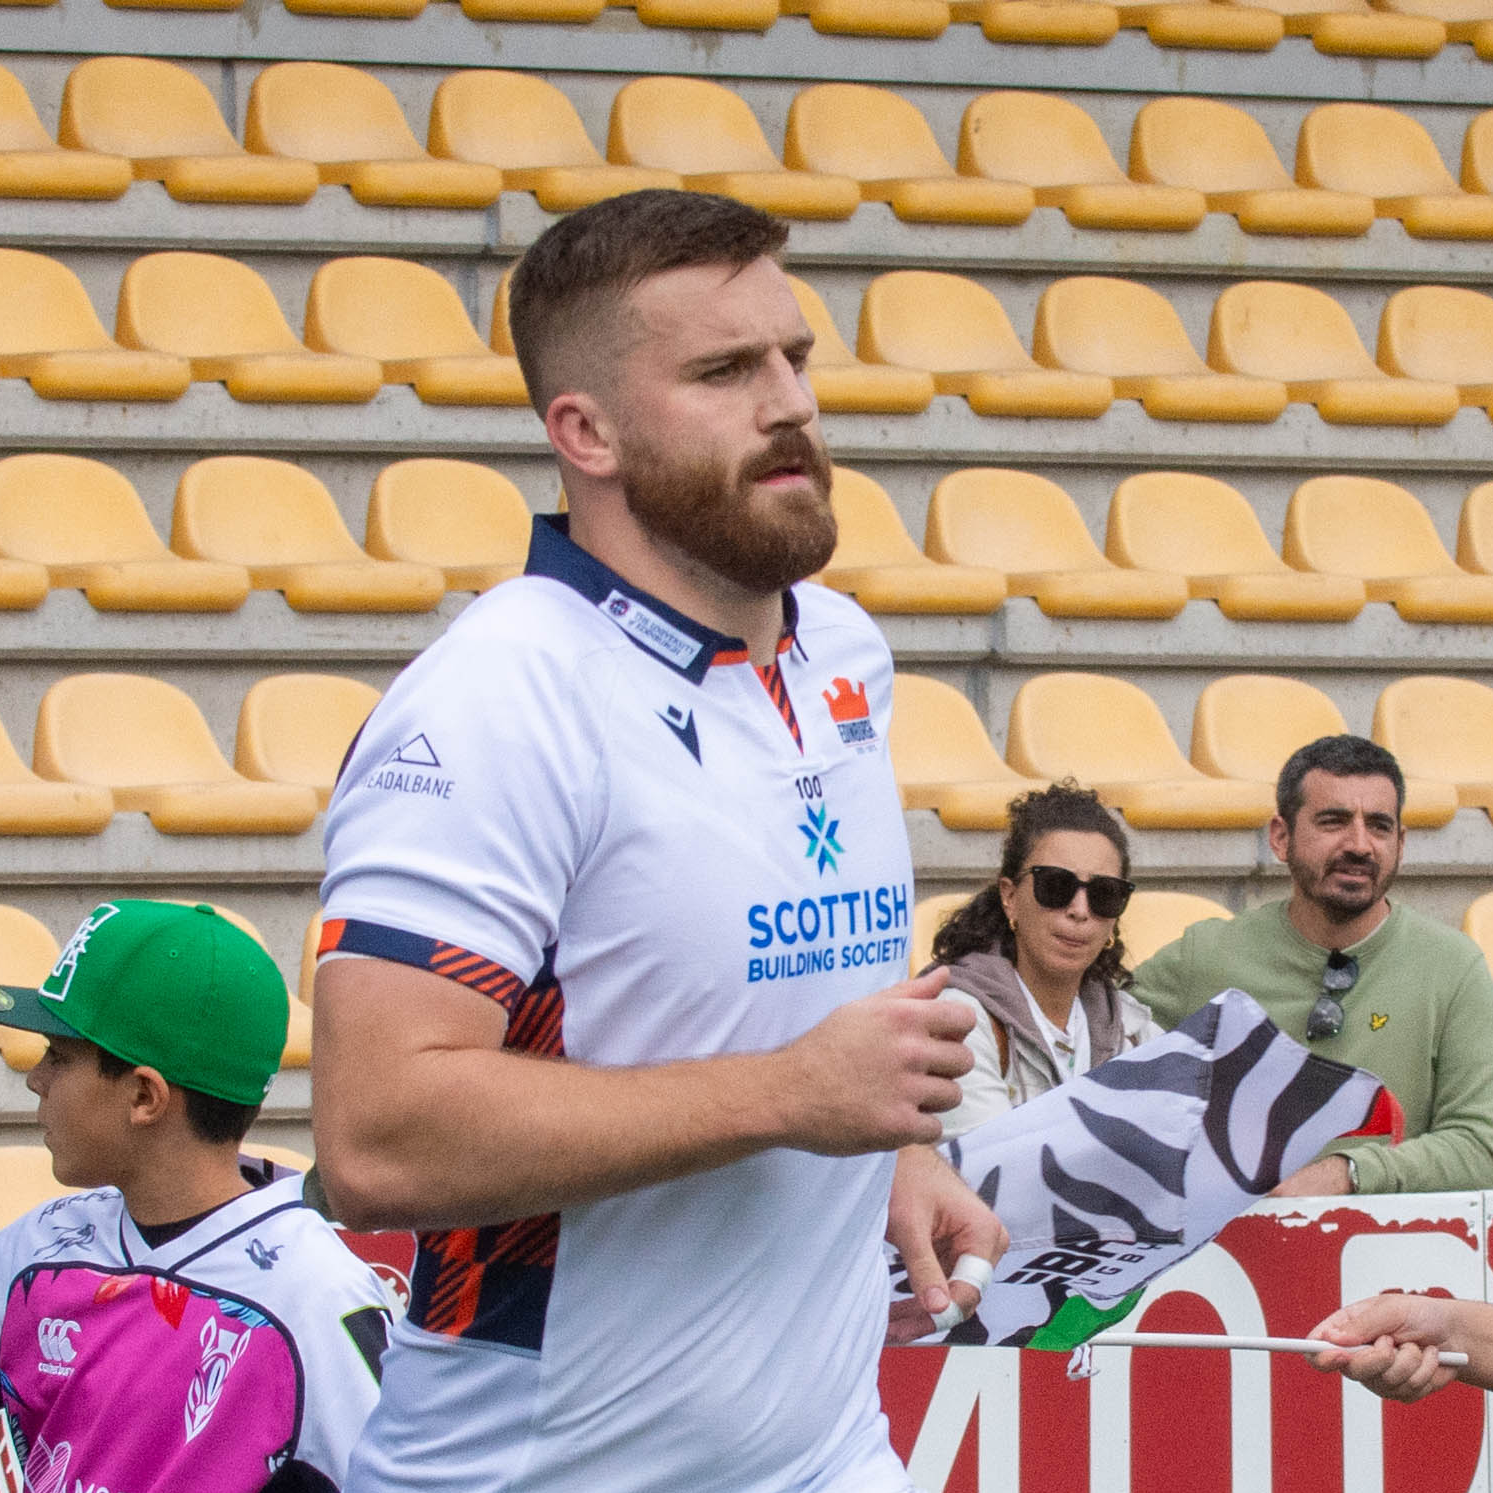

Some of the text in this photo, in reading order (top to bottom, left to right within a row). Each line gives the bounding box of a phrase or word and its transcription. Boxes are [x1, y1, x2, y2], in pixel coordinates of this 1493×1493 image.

[795, 775, 823, 800] 100
[748, 883, 907, 949] SCOTTISH
[747, 936, 907, 983] BUILDING SOCIETY
